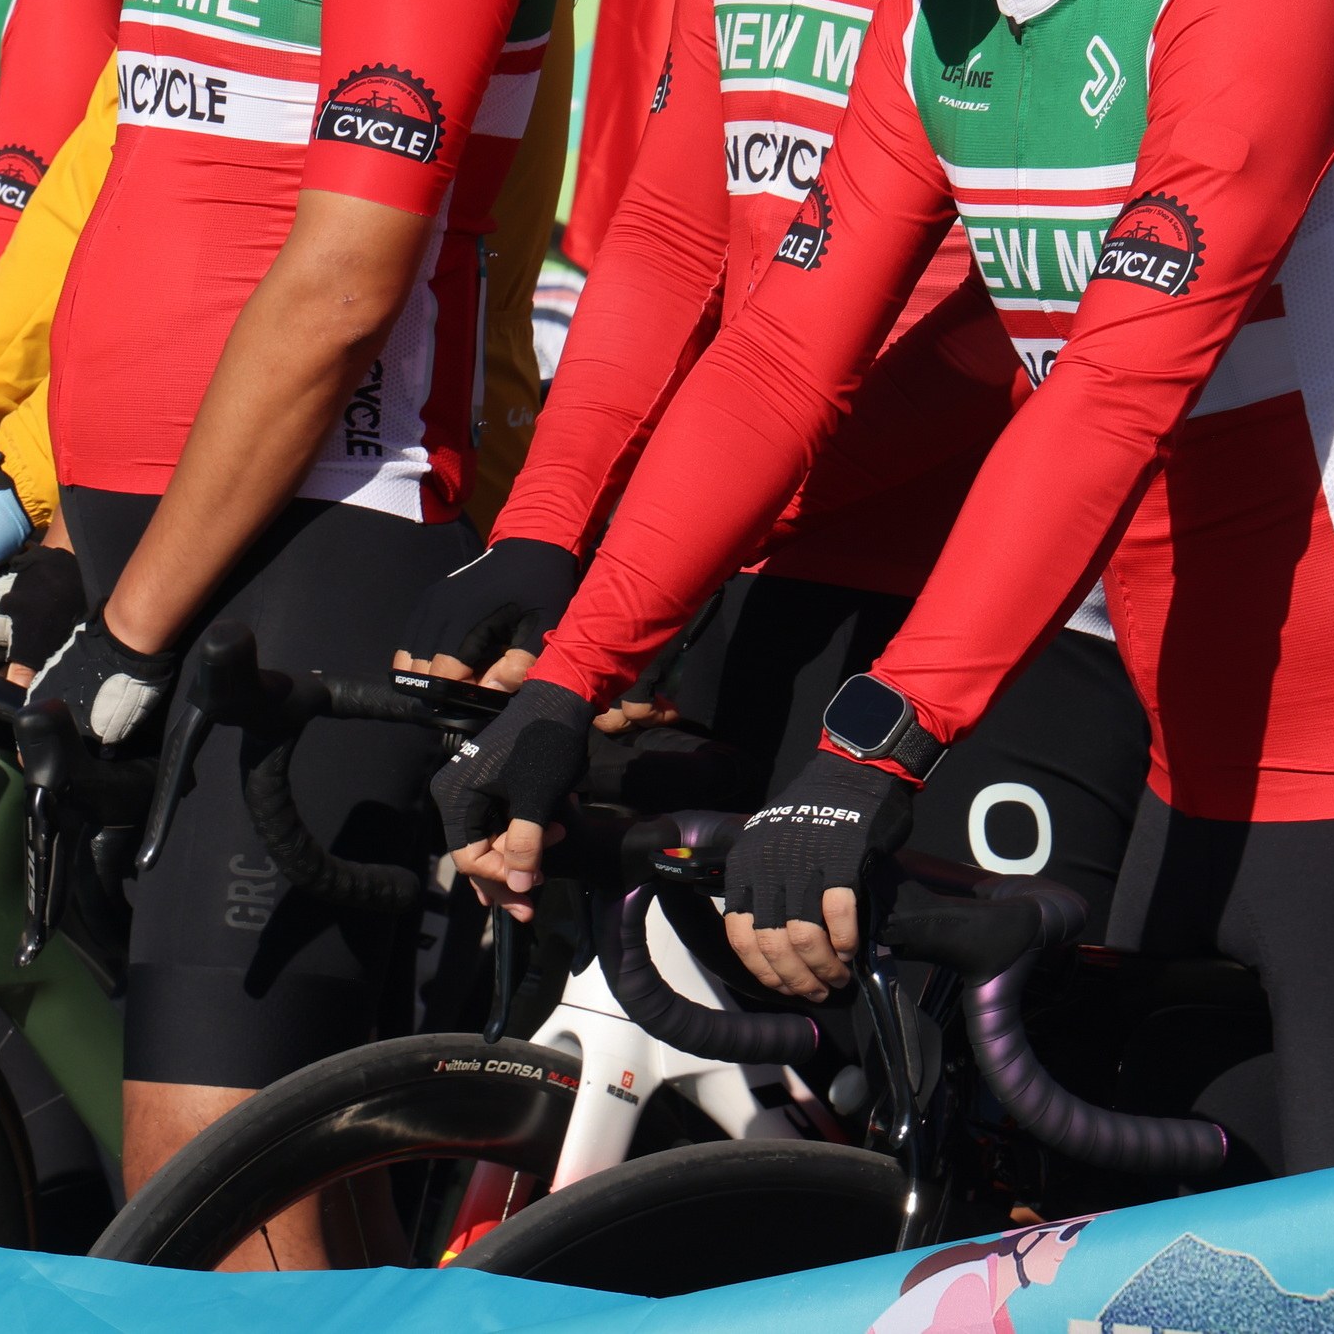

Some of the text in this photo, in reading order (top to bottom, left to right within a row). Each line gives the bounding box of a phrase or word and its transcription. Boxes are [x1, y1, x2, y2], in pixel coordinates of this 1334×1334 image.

[811, 20, 864, 88] M
[937, 95, 992, 112] PARDUS
[1094, 76, 1129, 130] JAKROO
[333, 113, 428, 157] CYCLE
[1097, 248, 1181, 289] CYCLE
[812, 817, 837, 827] RIDE
[483, 1058, 544, 1081] CORSA
